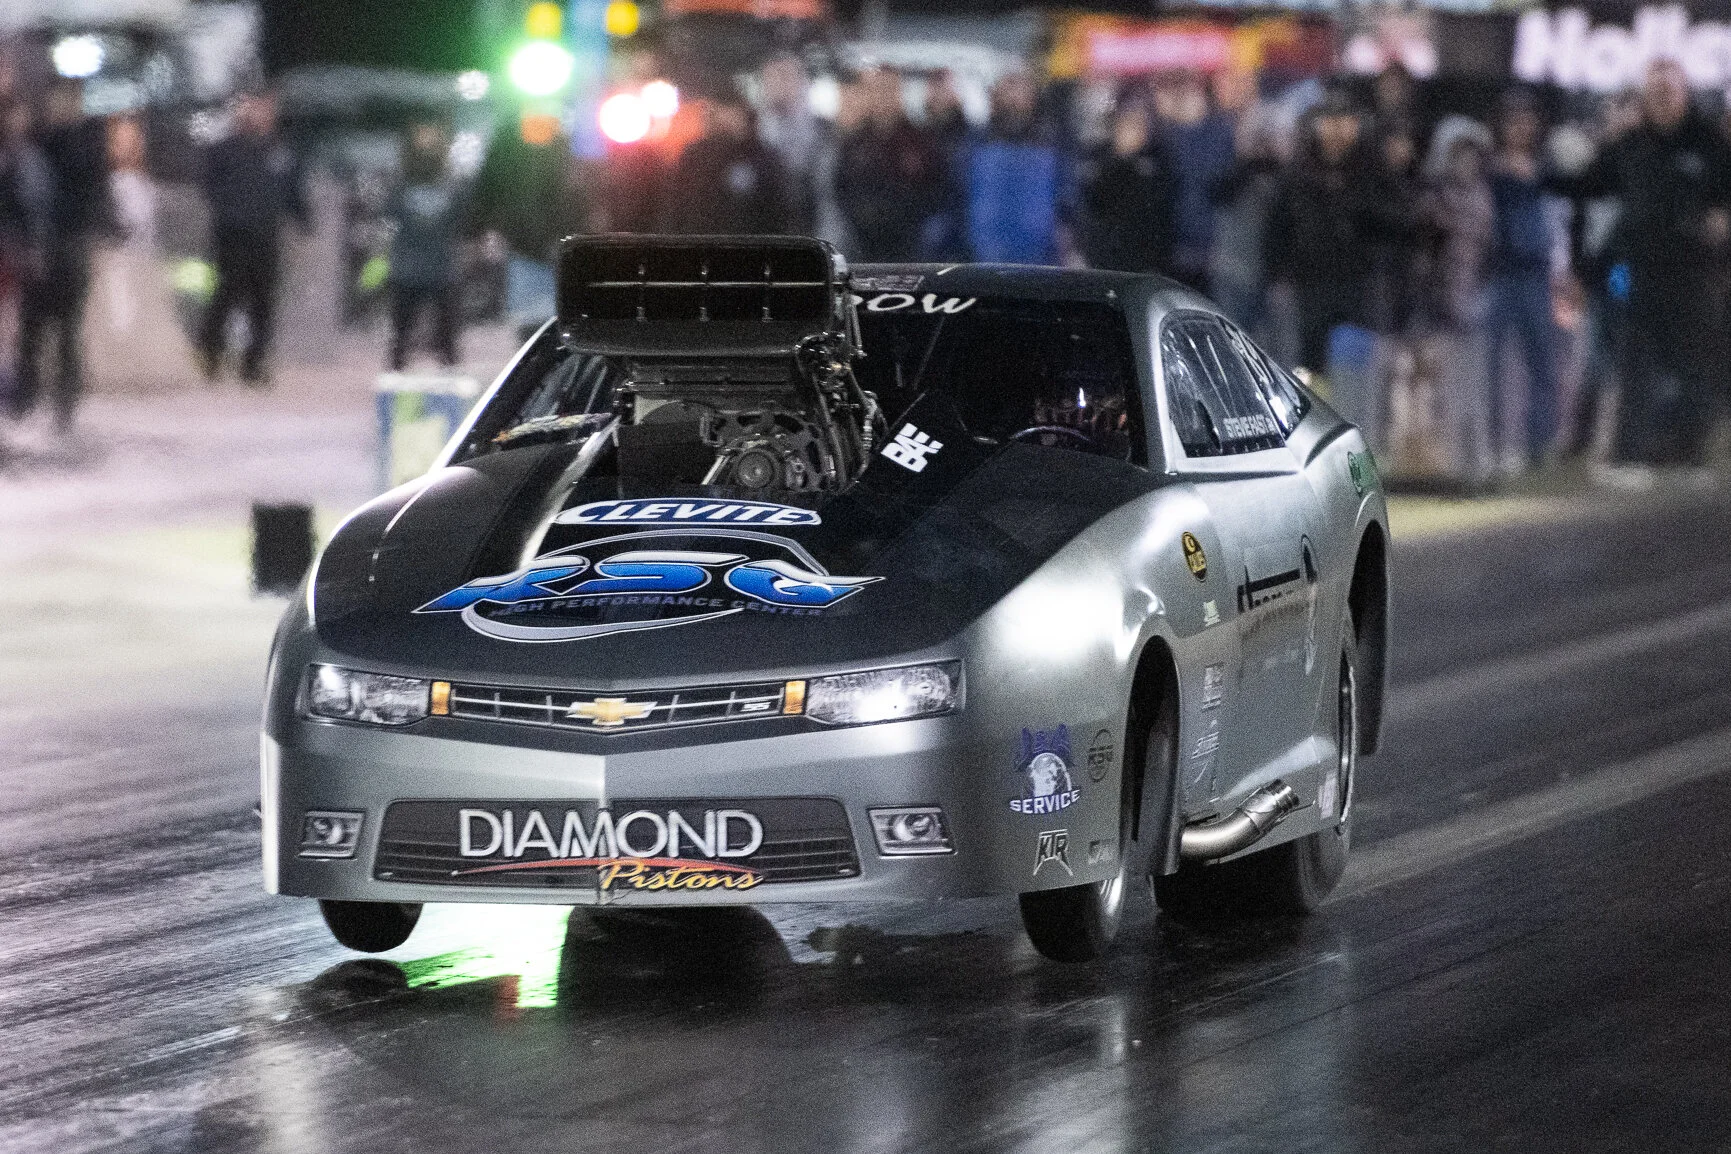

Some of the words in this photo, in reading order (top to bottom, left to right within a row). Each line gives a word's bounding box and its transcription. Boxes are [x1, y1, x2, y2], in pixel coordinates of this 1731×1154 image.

[556, 501, 818, 525] CLEVITE
[490, 602, 545, 617] HIGH
[551, 597, 723, 610] PERFORMANCE
[730, 599, 823, 616] CENTER
[1009, 789, 1081, 814] SERVICE
[459, 808, 764, 858] DIAMOND
[598, 859, 764, 890] Pistons
